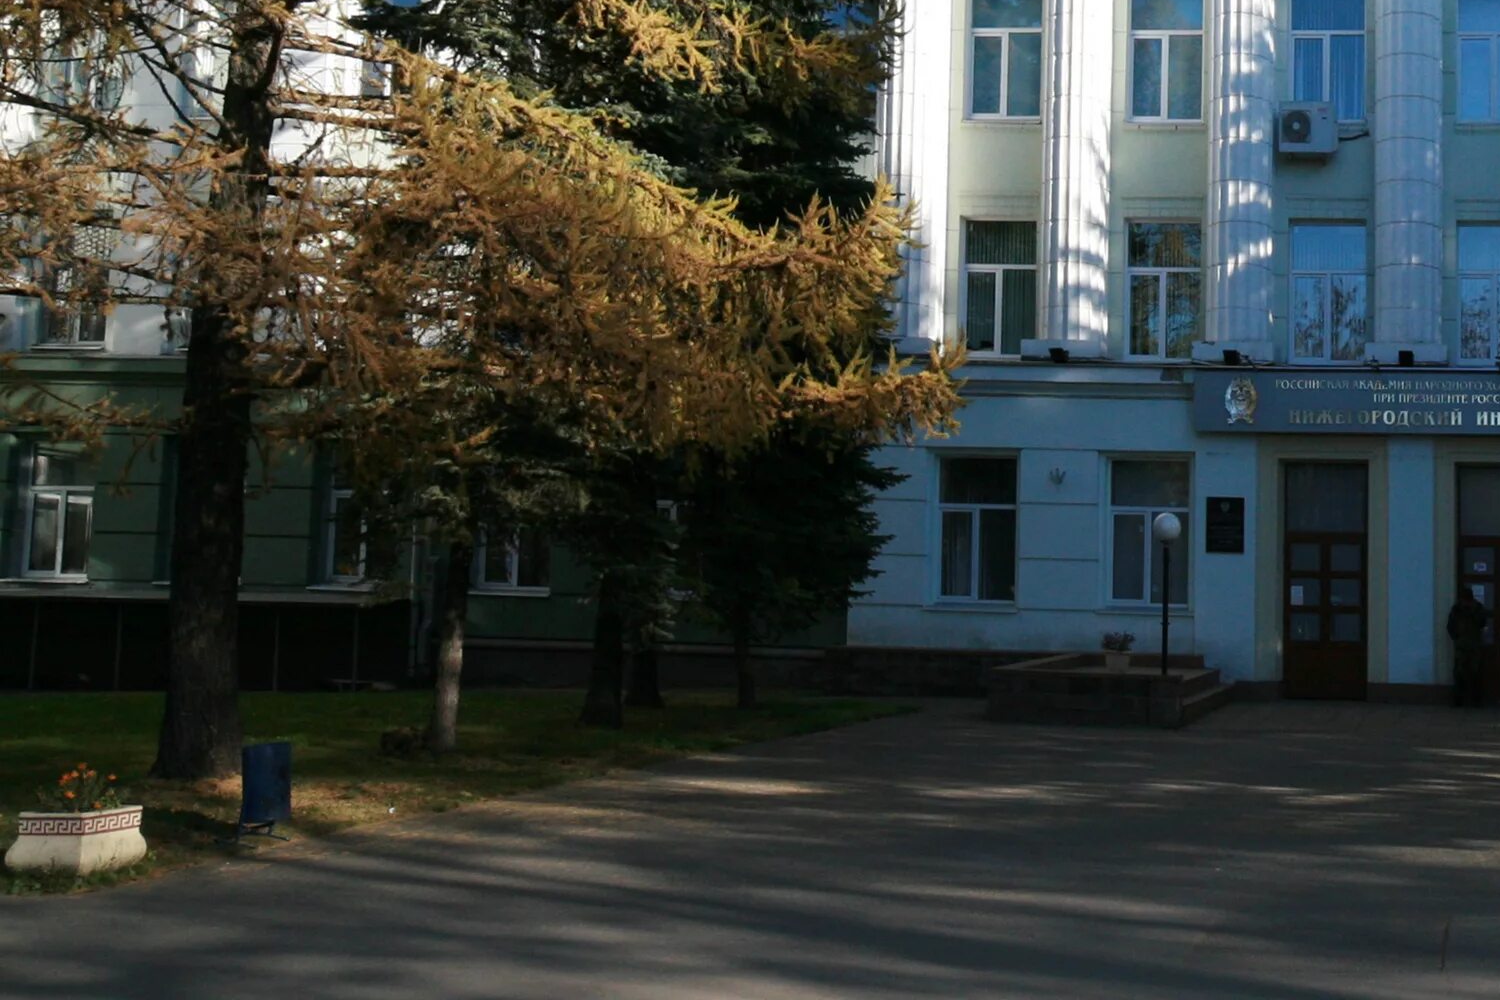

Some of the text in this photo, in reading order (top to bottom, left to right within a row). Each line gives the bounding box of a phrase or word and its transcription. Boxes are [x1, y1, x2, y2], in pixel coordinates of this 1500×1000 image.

[1373, 393, 1395, 403] ПРИ
[1399, 393, 1468, 404] ПРЕЗИДЕНТЕ
[1288, 408, 1462, 427] НИЖЕГОРОДСКИЙ
